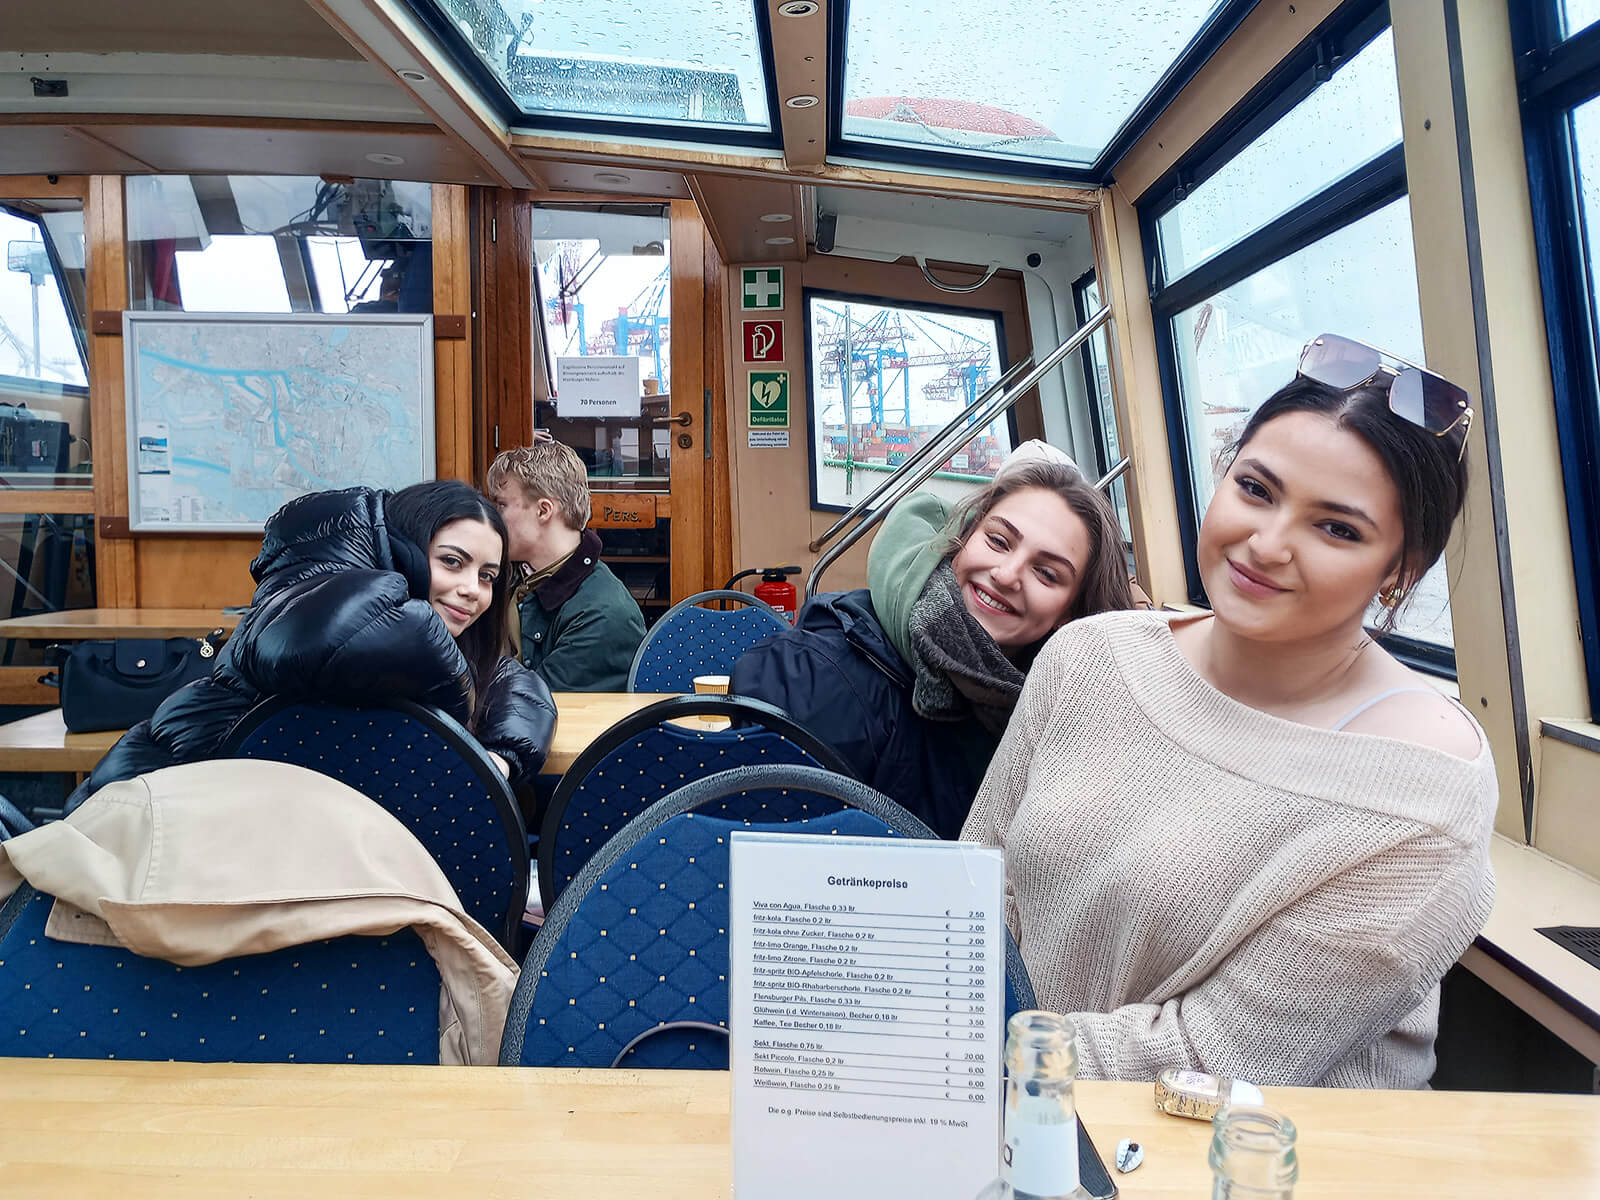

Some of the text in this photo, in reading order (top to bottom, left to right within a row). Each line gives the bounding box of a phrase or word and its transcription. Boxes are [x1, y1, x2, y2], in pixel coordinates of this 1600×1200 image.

[827, 875, 908, 889] Getränkepreise
[785, 915, 811, 923] Flasche
[753, 940, 782, 948] fritz-limo
[811, 943, 838, 951] Flasche
[753, 953, 782, 961] fritz-limo
[809, 956, 836, 964] Flasche
[846, 971, 873, 979] Flasche
[864, 986, 891, 994] Flasche
[753, 993, 793, 1003] Flensburger
[810, 996, 837, 1004] Flasche
[753, 1006, 785, 1014] Glühwein
[849, 1011, 873, 1019] Becher
[793, 1021, 817, 1029] Becher
[772, 1041, 798, 1049] Flasche
[784, 1067, 810, 1075] Flasche
[790, 1081, 816, 1089] Flasche
[768, 1106, 780, 1114] Die
[795, 1107, 817, 1116] Preise
[818, 1109, 832, 1117] sind
